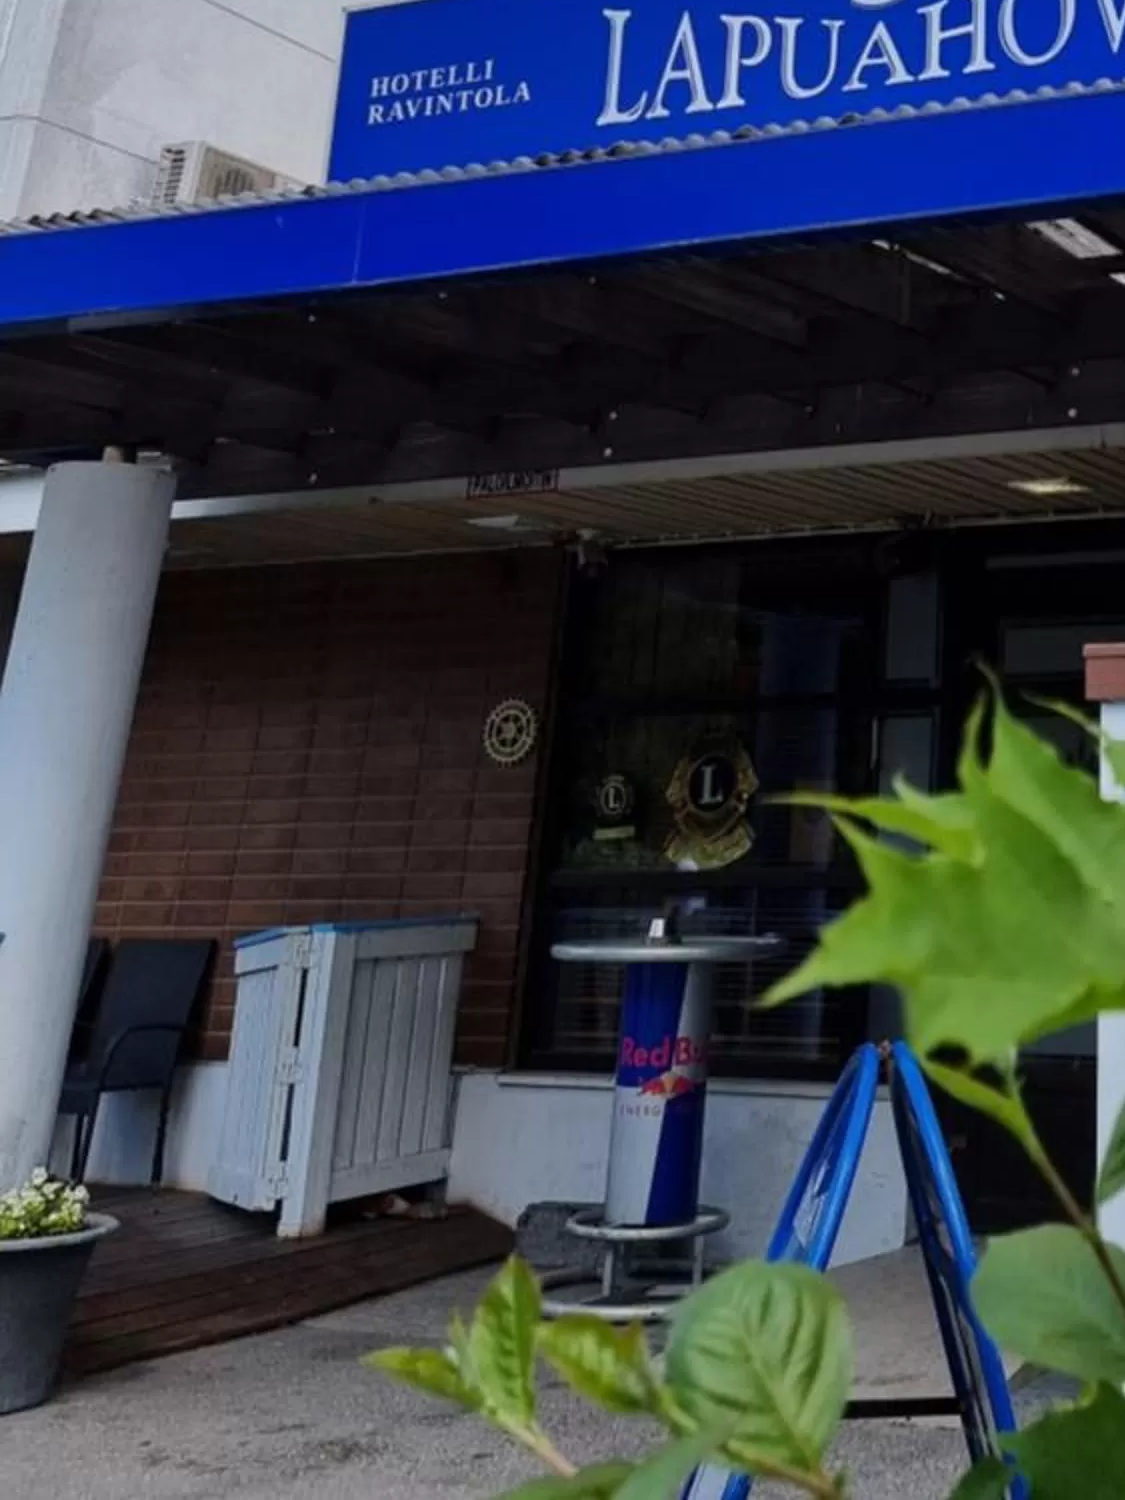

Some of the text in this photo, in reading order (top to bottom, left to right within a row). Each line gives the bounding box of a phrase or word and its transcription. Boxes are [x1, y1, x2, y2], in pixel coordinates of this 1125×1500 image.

[370, 58, 495, 99] HOTELLI
[367, 81, 531, 125] RAVINTOLA
[622, 1034, 671, 1068] Red
